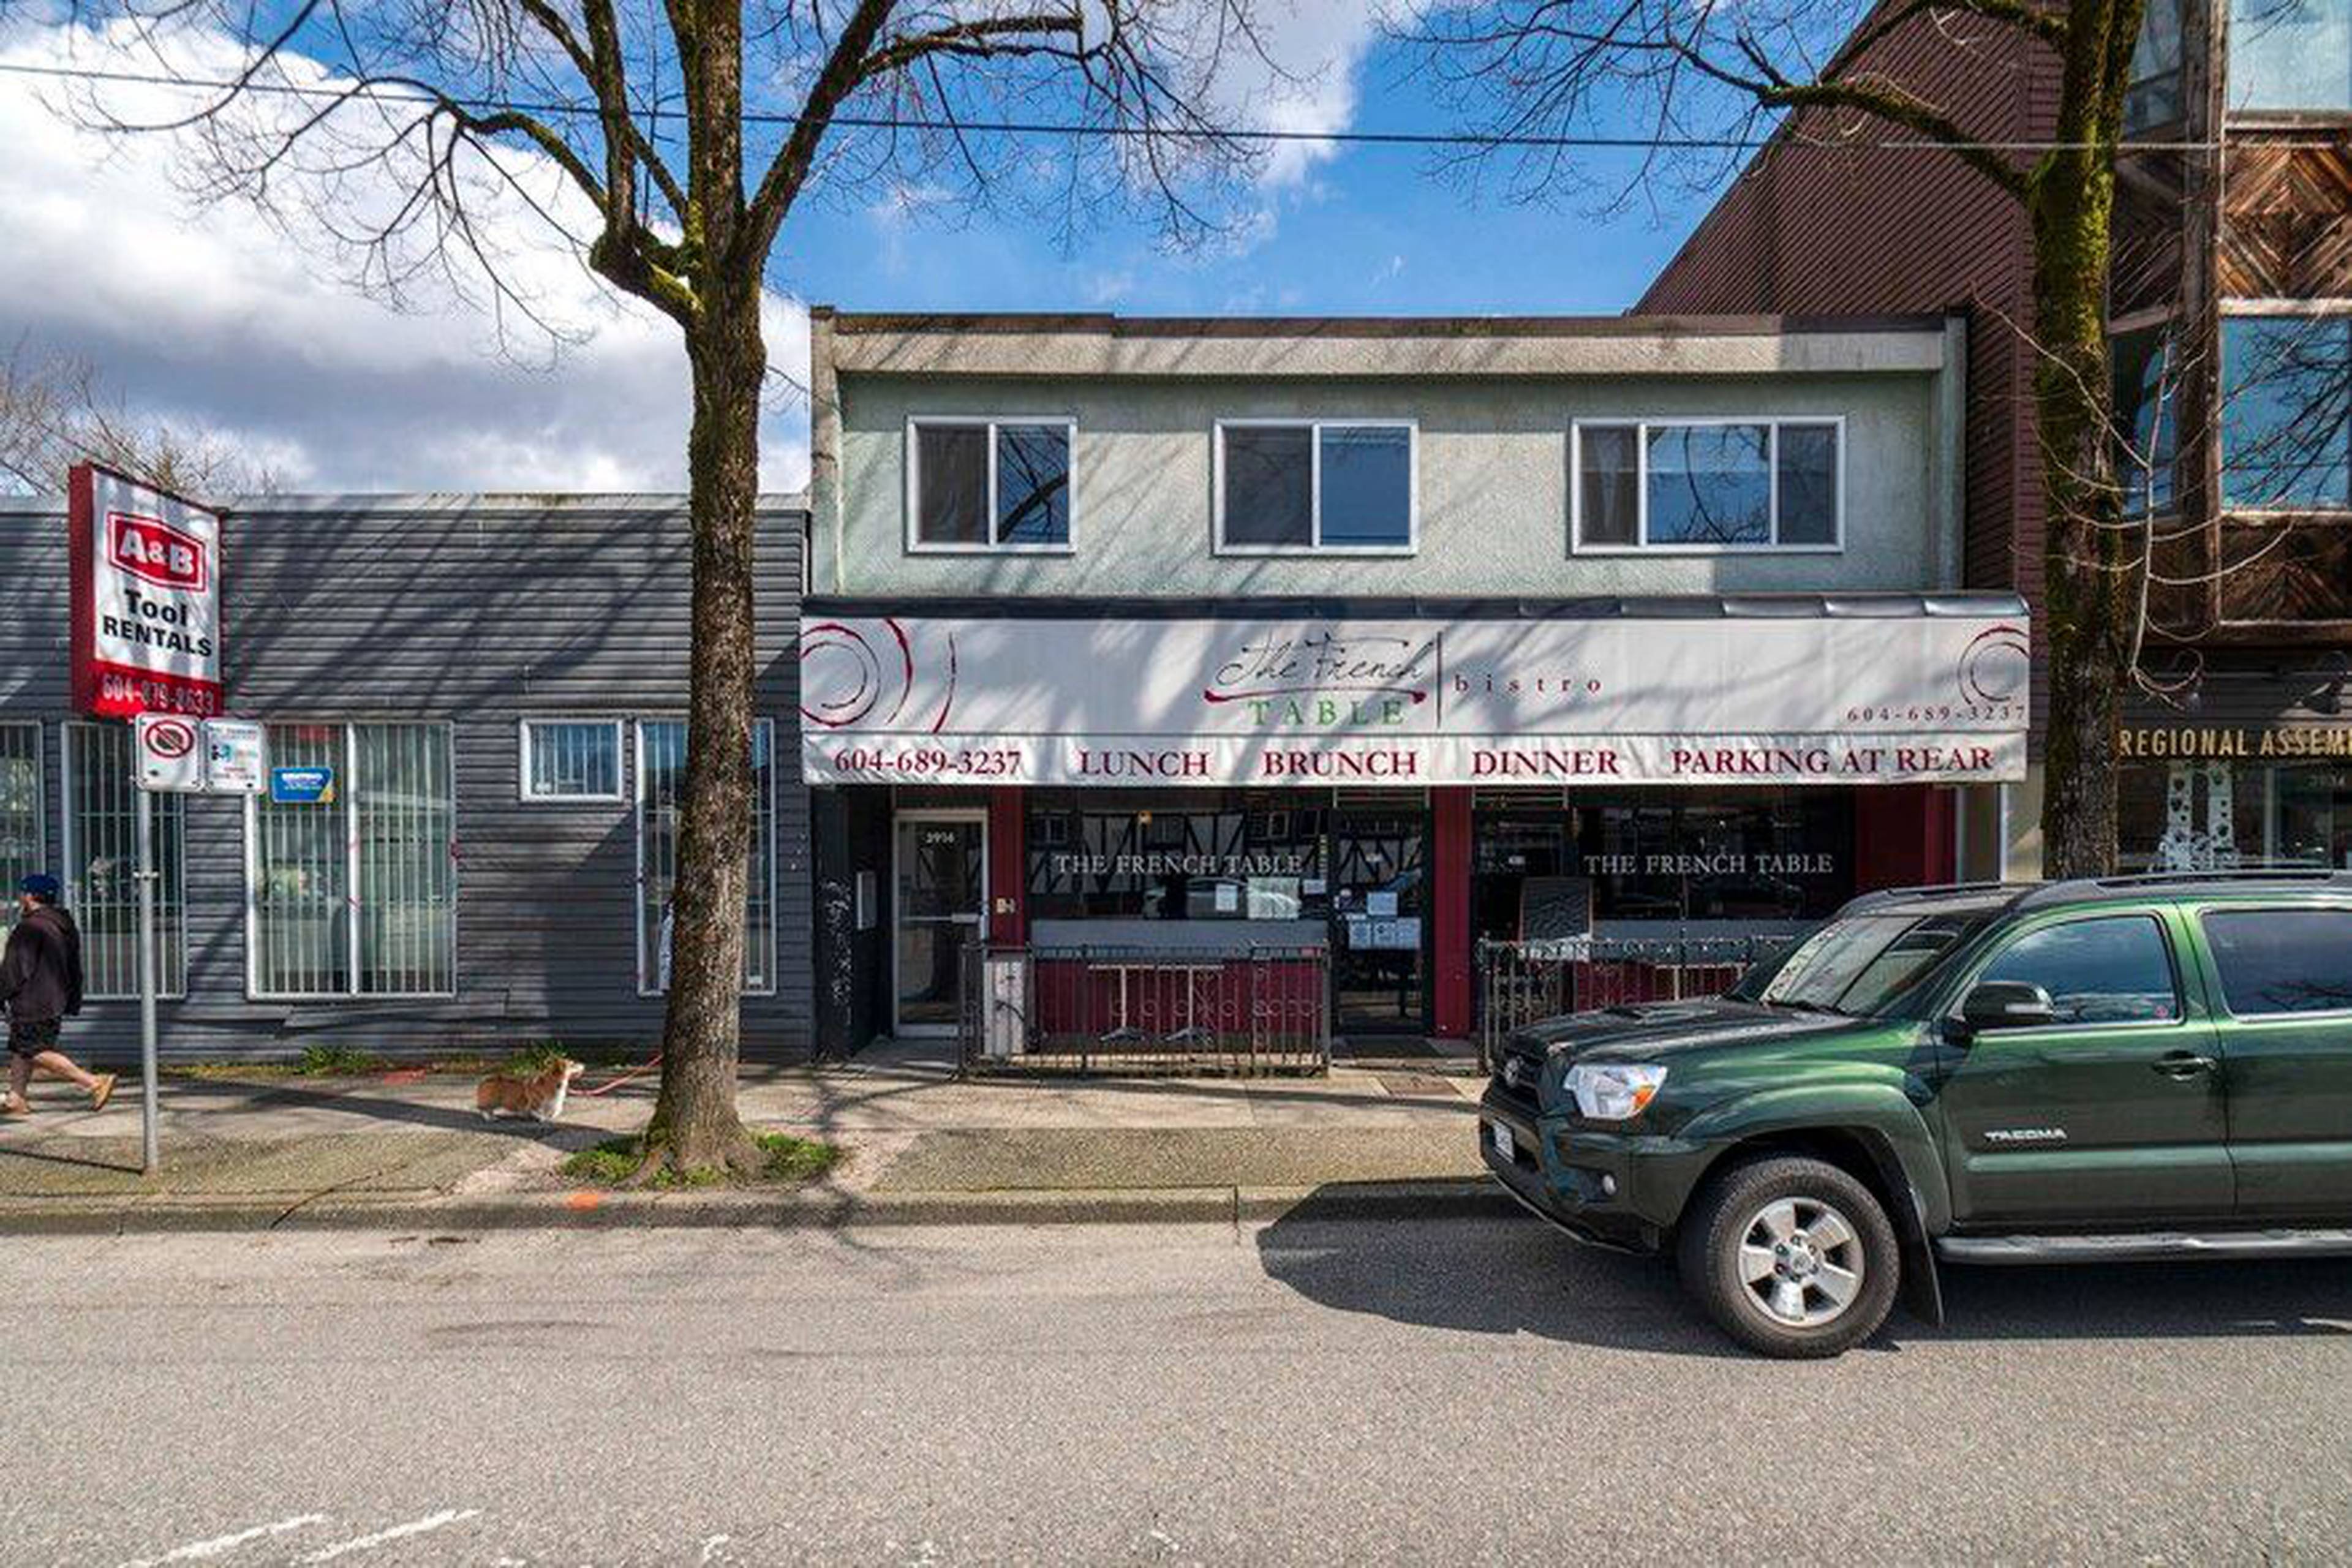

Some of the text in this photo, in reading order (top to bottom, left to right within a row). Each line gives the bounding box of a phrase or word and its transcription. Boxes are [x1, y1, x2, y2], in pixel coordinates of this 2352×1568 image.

[121, 529, 194, 575] A&B
[124, 589, 187, 627] Tool
[103, 615, 212, 657] RENTALS
[1455, 674, 1601, 693] bistro
[1247, 700, 1404, 726] TABLE
[1846, 705, 2025, 723] 604-689-3237
[2119, 728, 2248, 756] REGIONAL
[834, 745, 1995, 777] 604-689-3237 LUNCH BRUNCH DINNER PARKING AT REAR
[1054, 854, 1303, 875] THE FRENCH TABLE
[1583, 854, 1834, 875] THE FRENCH TABLE
